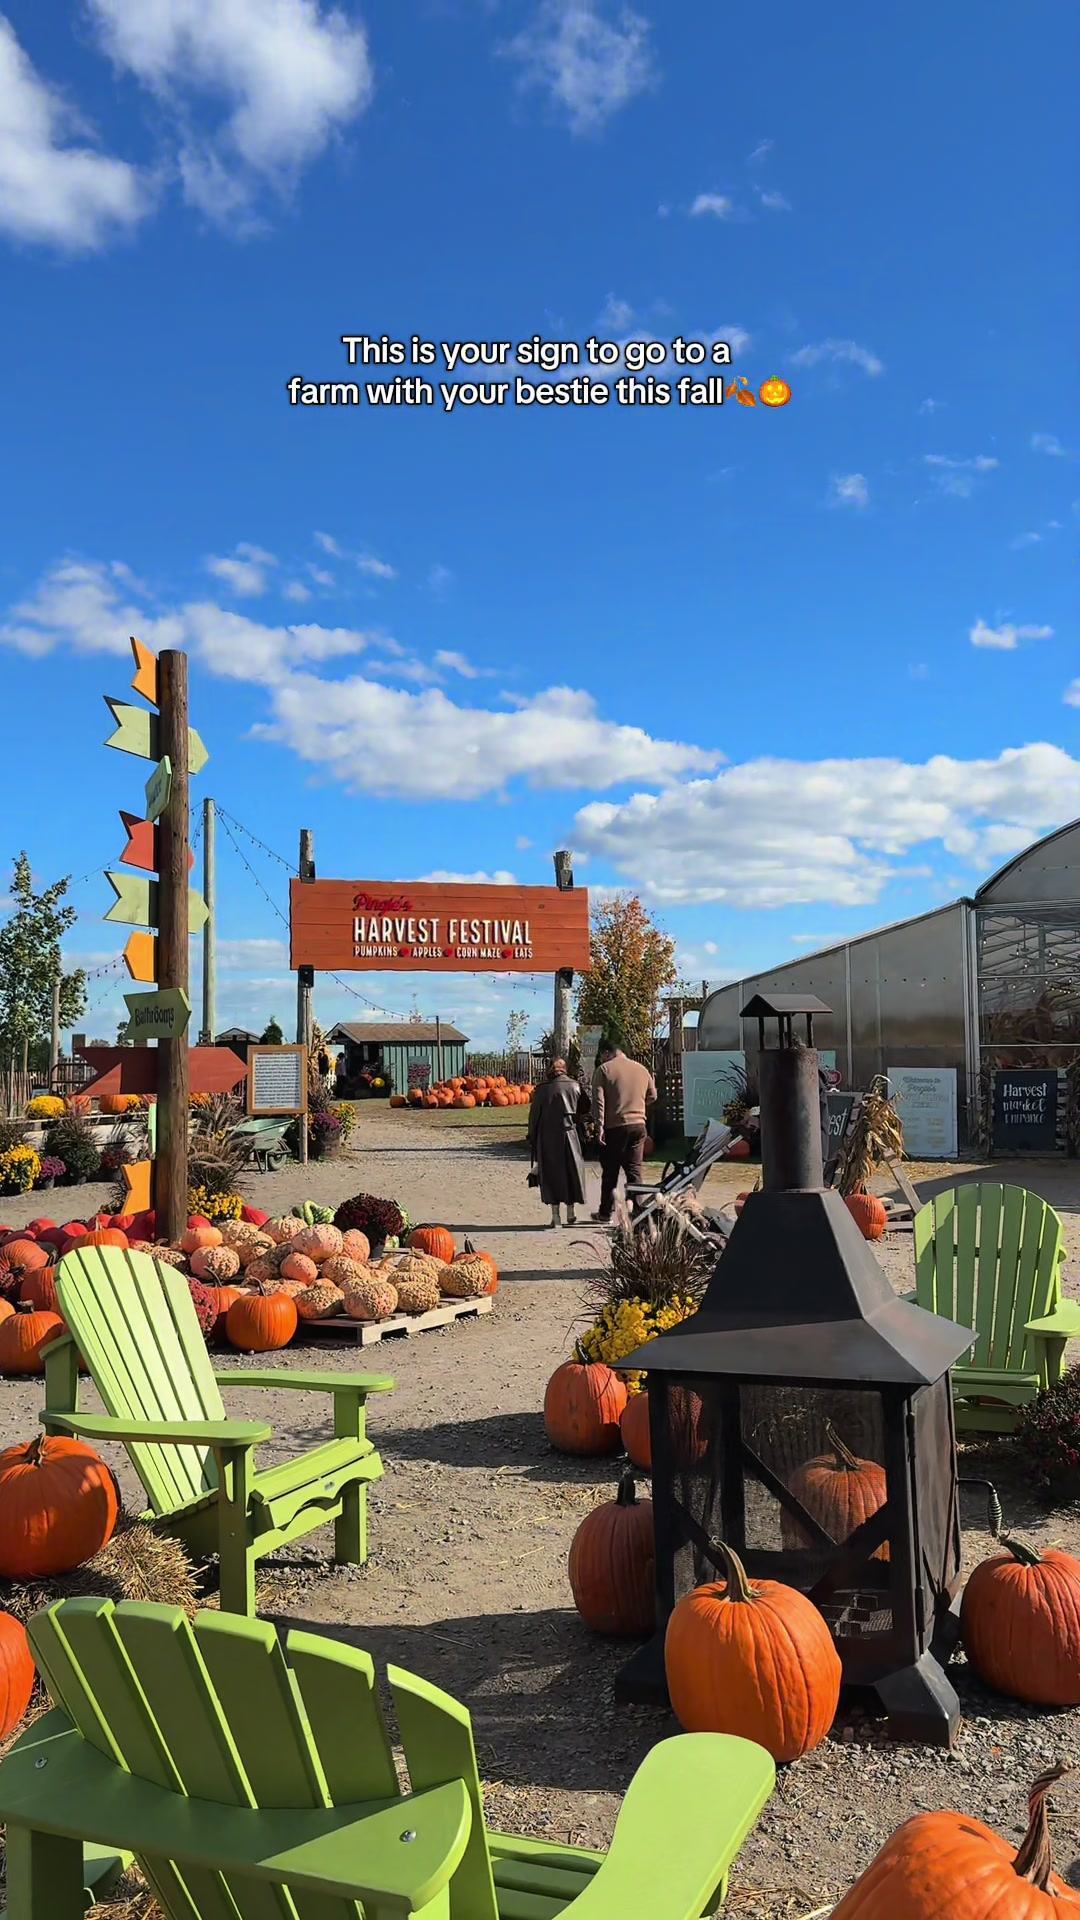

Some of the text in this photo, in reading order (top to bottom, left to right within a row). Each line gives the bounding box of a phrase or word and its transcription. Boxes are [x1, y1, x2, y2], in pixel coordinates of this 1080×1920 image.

[354, 917, 533, 945] HARVEST FESTIVAL
[354, 945, 533, 959] PUMPKINS APPLES CORN MAZE EATS
[1003, 1083, 1047, 1097] Harvest
[1003, 1098, 1047, 1112] market
[828, 1107, 848, 1136] est
